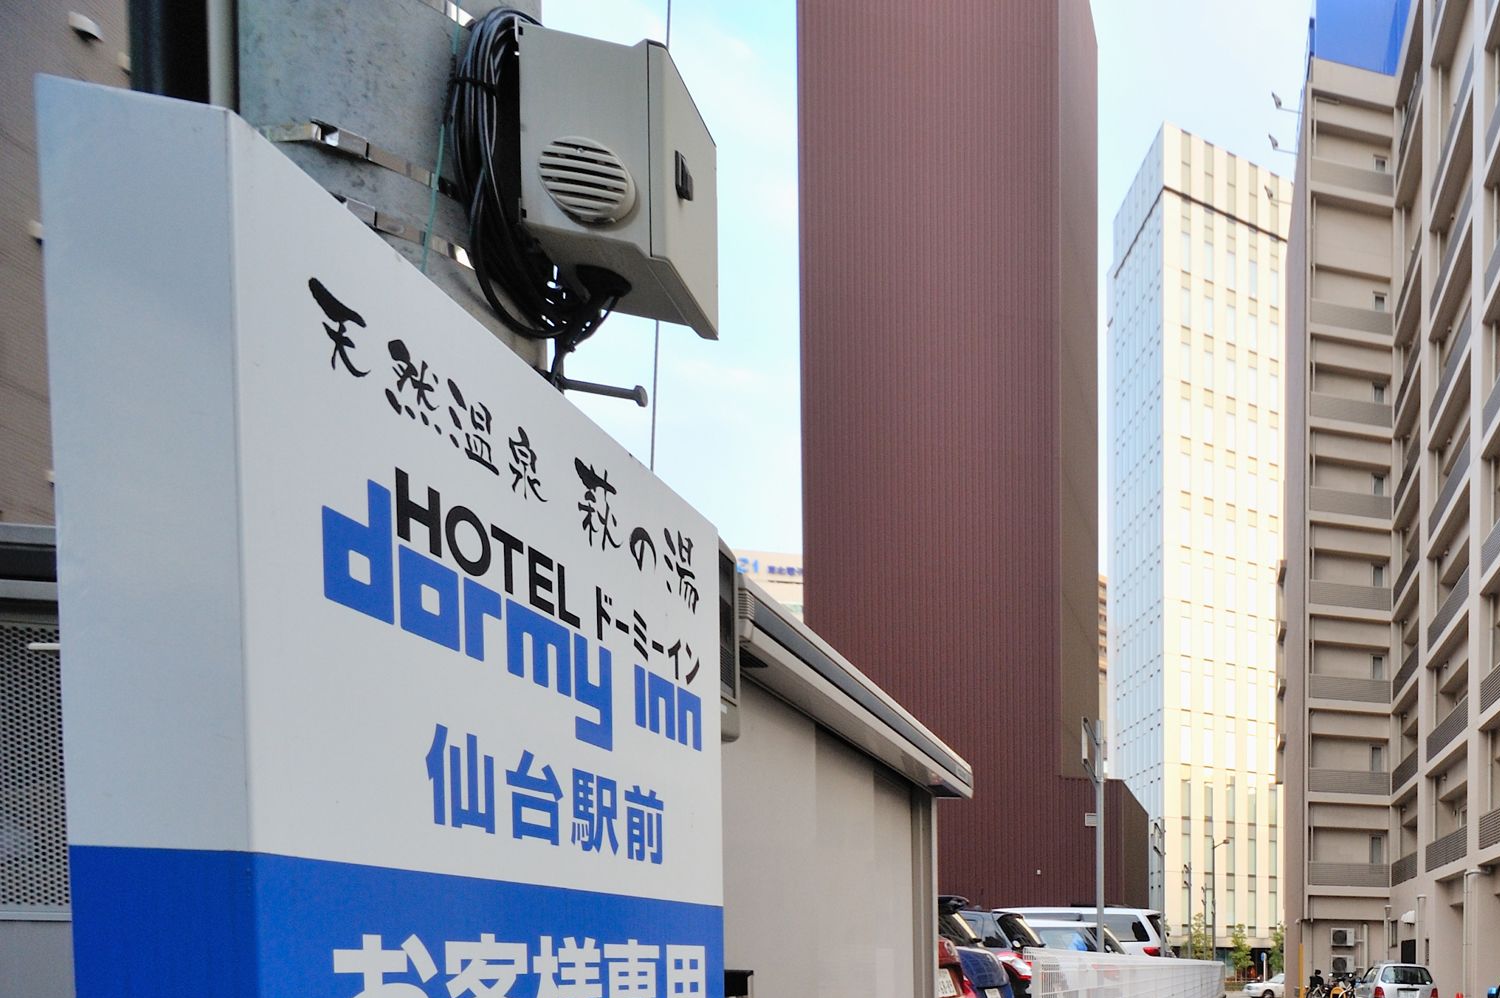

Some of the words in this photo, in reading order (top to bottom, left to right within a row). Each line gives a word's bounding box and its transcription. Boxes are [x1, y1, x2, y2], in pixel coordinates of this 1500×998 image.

[308, 277, 548, 503] 天然温泉
[574, 456, 700, 613] 萩の湯
[322, 478, 613, 751] dormy
[634, 664, 702, 751] inn
[395, 467, 581, 628] HOTEL
[595, 585, 700, 685] ドーミーイン
[425, 723, 664, 866] 仙台駅前
